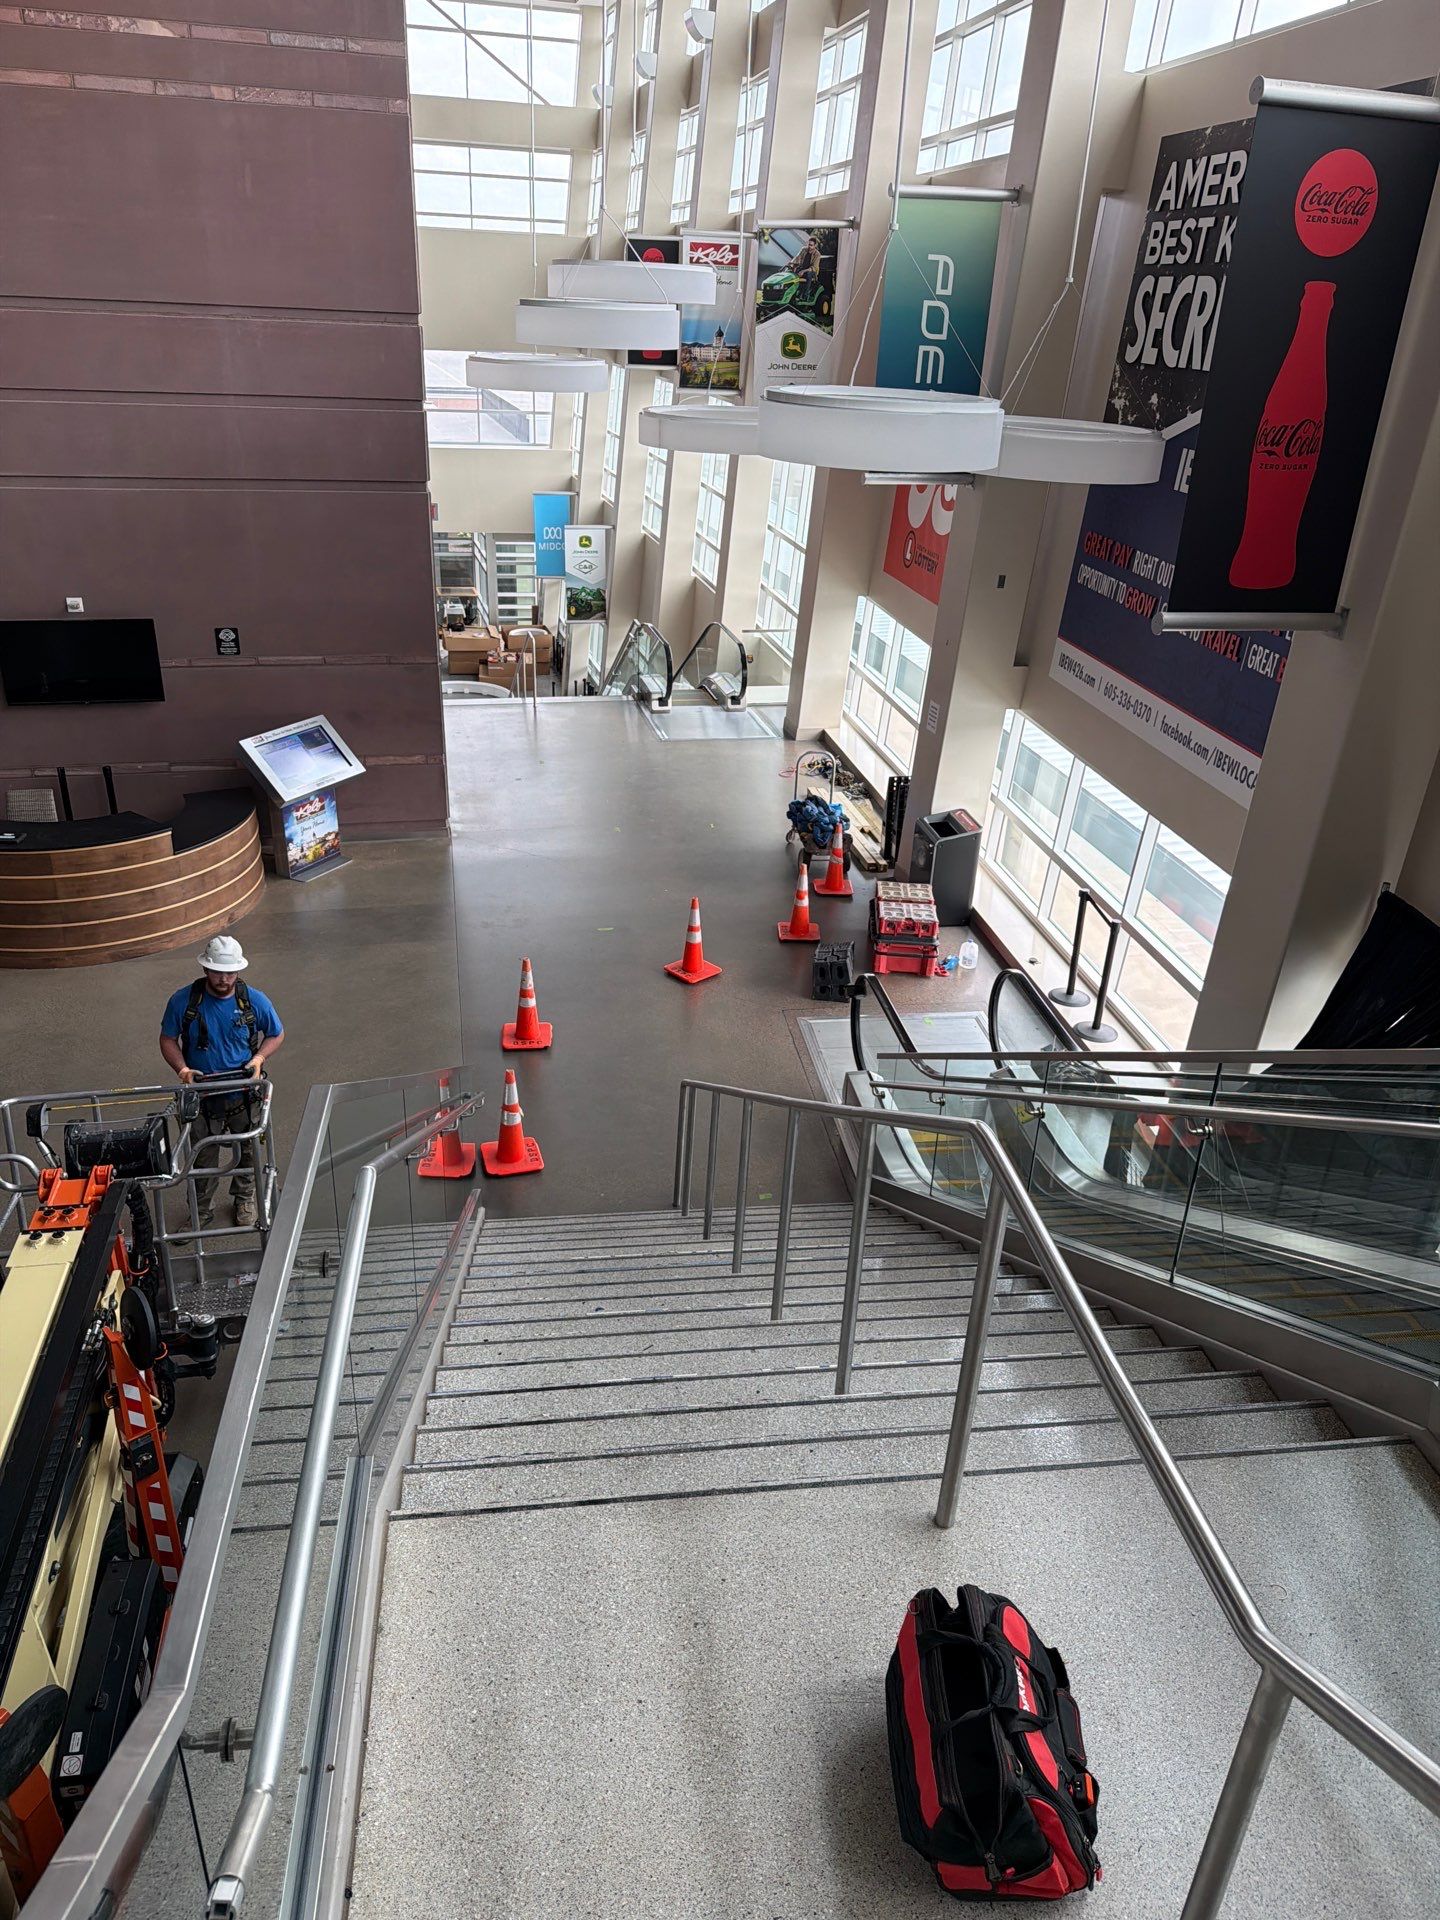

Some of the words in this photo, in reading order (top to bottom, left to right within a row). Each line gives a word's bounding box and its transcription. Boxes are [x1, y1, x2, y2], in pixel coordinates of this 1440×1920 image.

[1144, 216, 1215, 265] BEST
[1306, 215, 1328, 223] ZERO
[1331, 216, 1359, 225] SUGAR
[915, 254, 954, 385] POE
[768, 363, 790, 371] JOHN
[791, 363, 818, 371] DEERE
[915, 552, 939, 575] LOTTERY
[1084, 531, 1113, 561] GREAT
[1113, 542, 1133, 570] PAY
[1132, 551, 1159, 581] RIGHT
[1157, 561, 1175, 588] OUT
[1077, 564, 1118, 600] OPPORTUNITY
[1116, 582, 1127, 604] TO
[1124, 587, 1156, 618] GROW
[1247, 644, 1280, 678] GREAT
[1058, 652, 1096, 688] IBEW426.com
[1103, 681, 1152, 723] 605-336-0370
